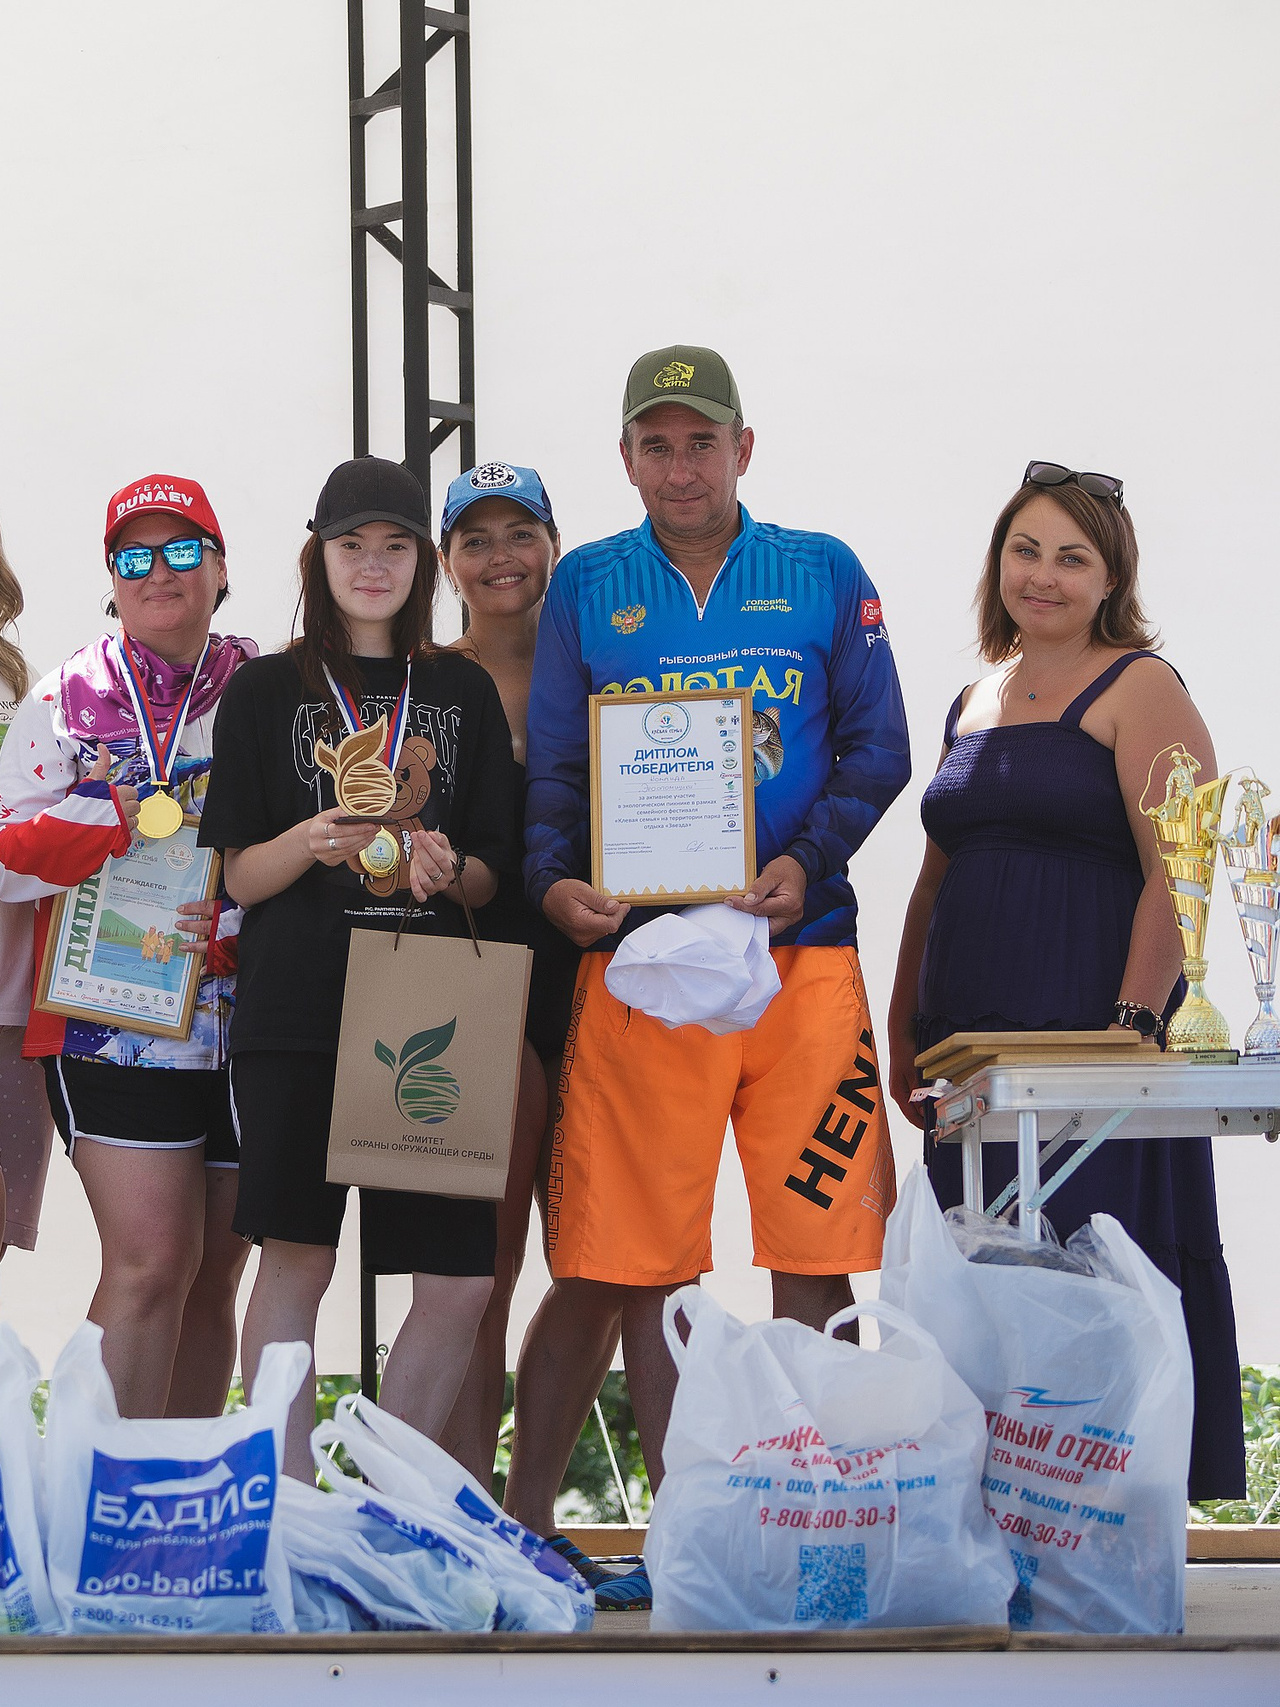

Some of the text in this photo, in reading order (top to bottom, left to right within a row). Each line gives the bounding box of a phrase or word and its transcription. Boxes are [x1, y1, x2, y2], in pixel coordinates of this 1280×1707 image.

[135, 483, 174, 495] TEAM
[116, 490, 194, 518] DUNAEV
[740, 604, 793, 613] АЛЕКСАНДР
[745, 598, 788, 606] ГОЛОВИН
[659, 647, 803, 665] РЫБОЛОВНЫЙ ФЕСТИВАЛЬ
[634, 747, 699, 761] ДИПЛОМ
[619, 760, 715, 775] ПОБЕДИТЕЛЯ
[112, 875, 168, 891] НАГРАЖДАЕТСЯ
[402, 1134, 445, 1145] КОМИТЕТ
[350, 1139, 494, 1160] ОХРАНЫ ОКРУЖАЮЩЕЙ СРЕДЫ
[92, 1474, 270, 1532] БАДИС
[90, 1531, 113, 1545] все
[71, 1606, 194, 1630] 8-800-201-62-15
